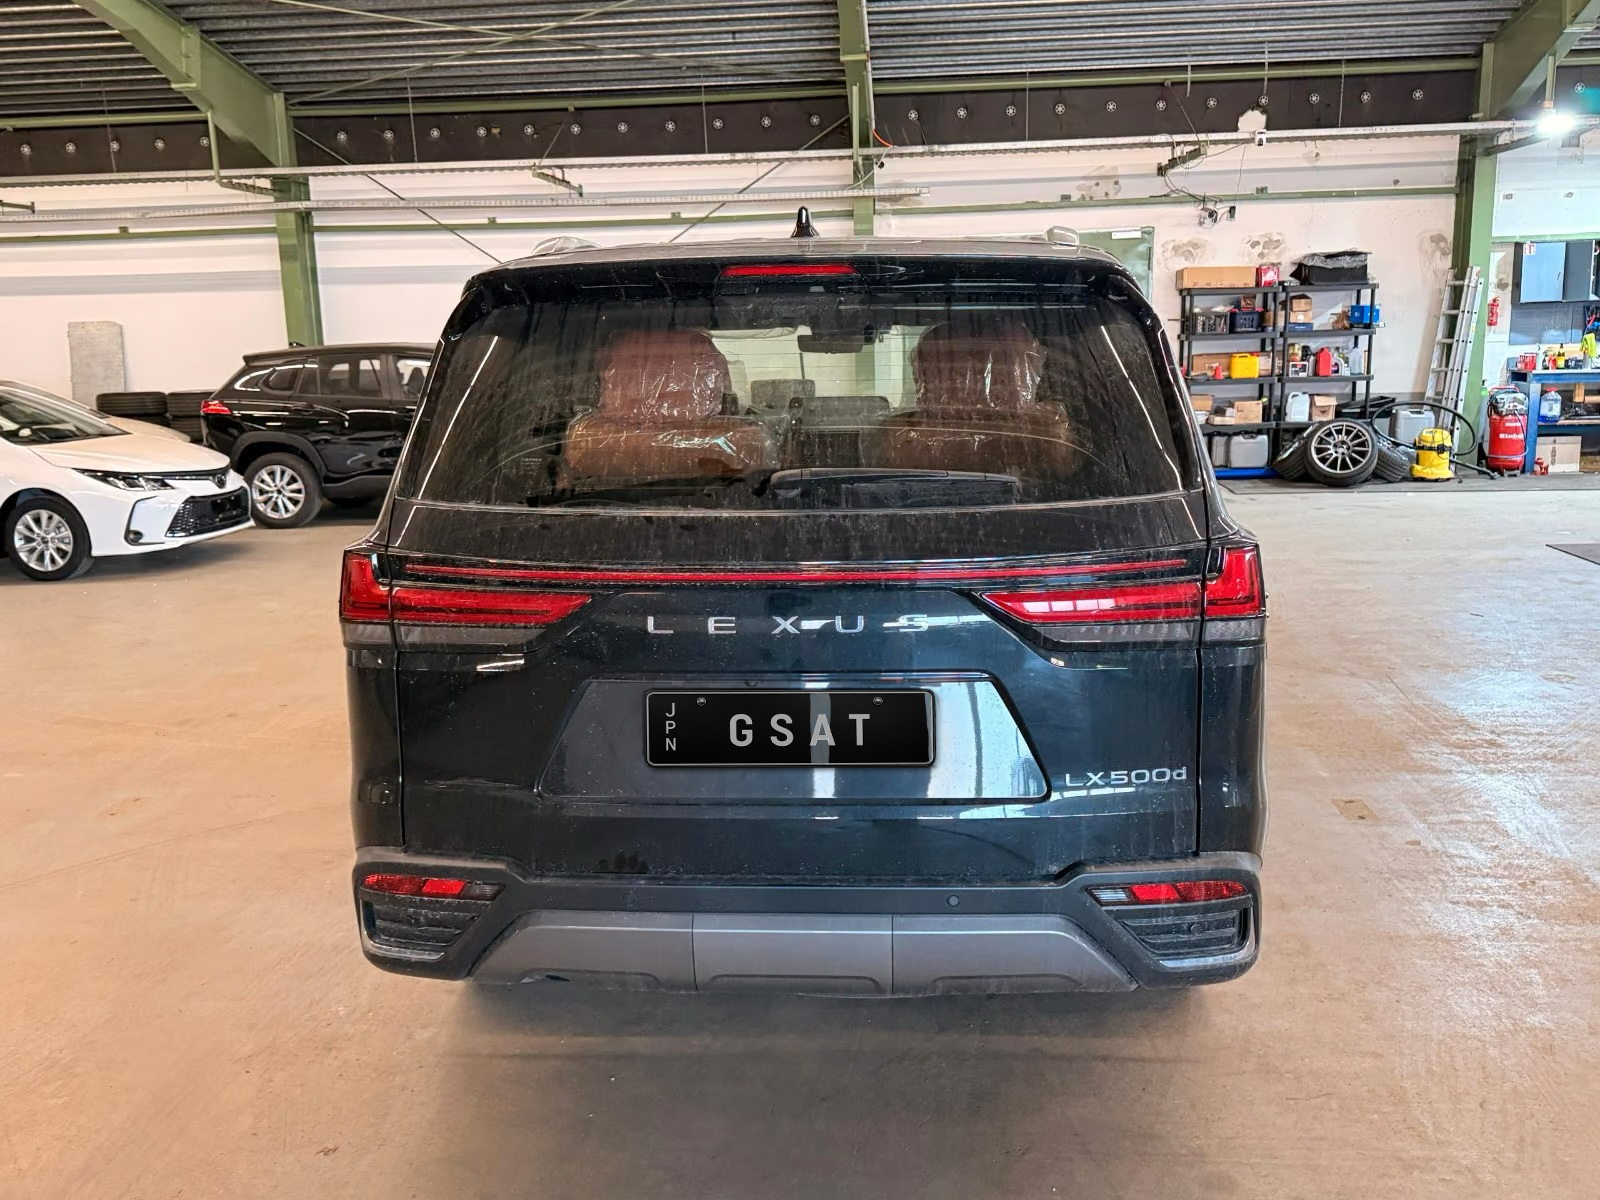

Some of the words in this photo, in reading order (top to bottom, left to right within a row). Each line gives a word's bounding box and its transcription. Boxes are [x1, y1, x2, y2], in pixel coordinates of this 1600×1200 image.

[647, 614, 929, 634] LEXUS
[665, 702, 676, 751] JPN
[729, 713, 871, 747] GSAT
